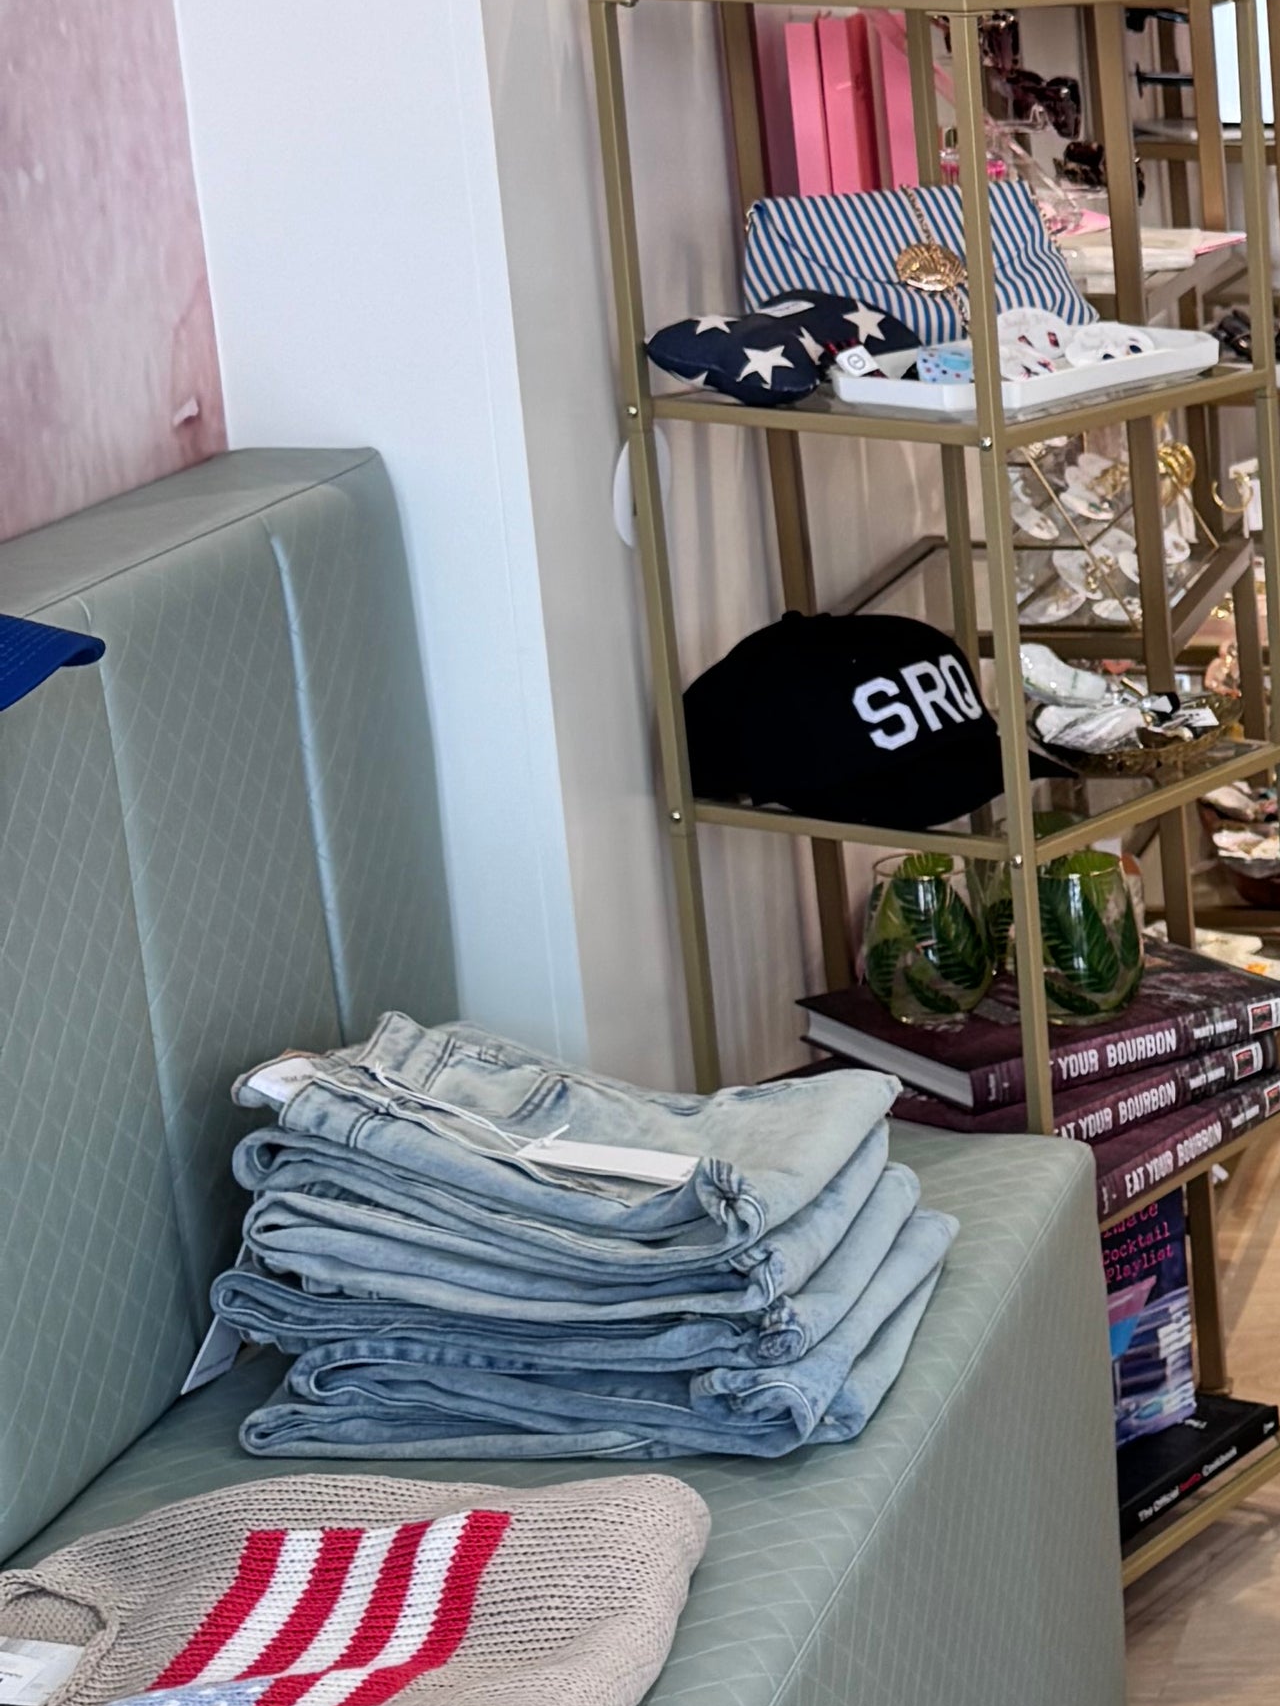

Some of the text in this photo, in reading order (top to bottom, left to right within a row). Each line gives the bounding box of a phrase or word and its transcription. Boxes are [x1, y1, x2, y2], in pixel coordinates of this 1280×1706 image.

[852, 654, 983, 751] SRQ
[1058, 1048, 1099, 1081] YOUR
[1107, 1028, 1177, 1068] BOURBON
[1078, 1106, 1112, 1140] YOUR
[1118, 1080, 1177, 1125] BOURBON
[1124, 1120, 1222, 1198] EAT YOUR BOURBON
[1102, 1221, 1170, 1265] Cocktail
[1105, 1244, 1173, 1284] Playlist
